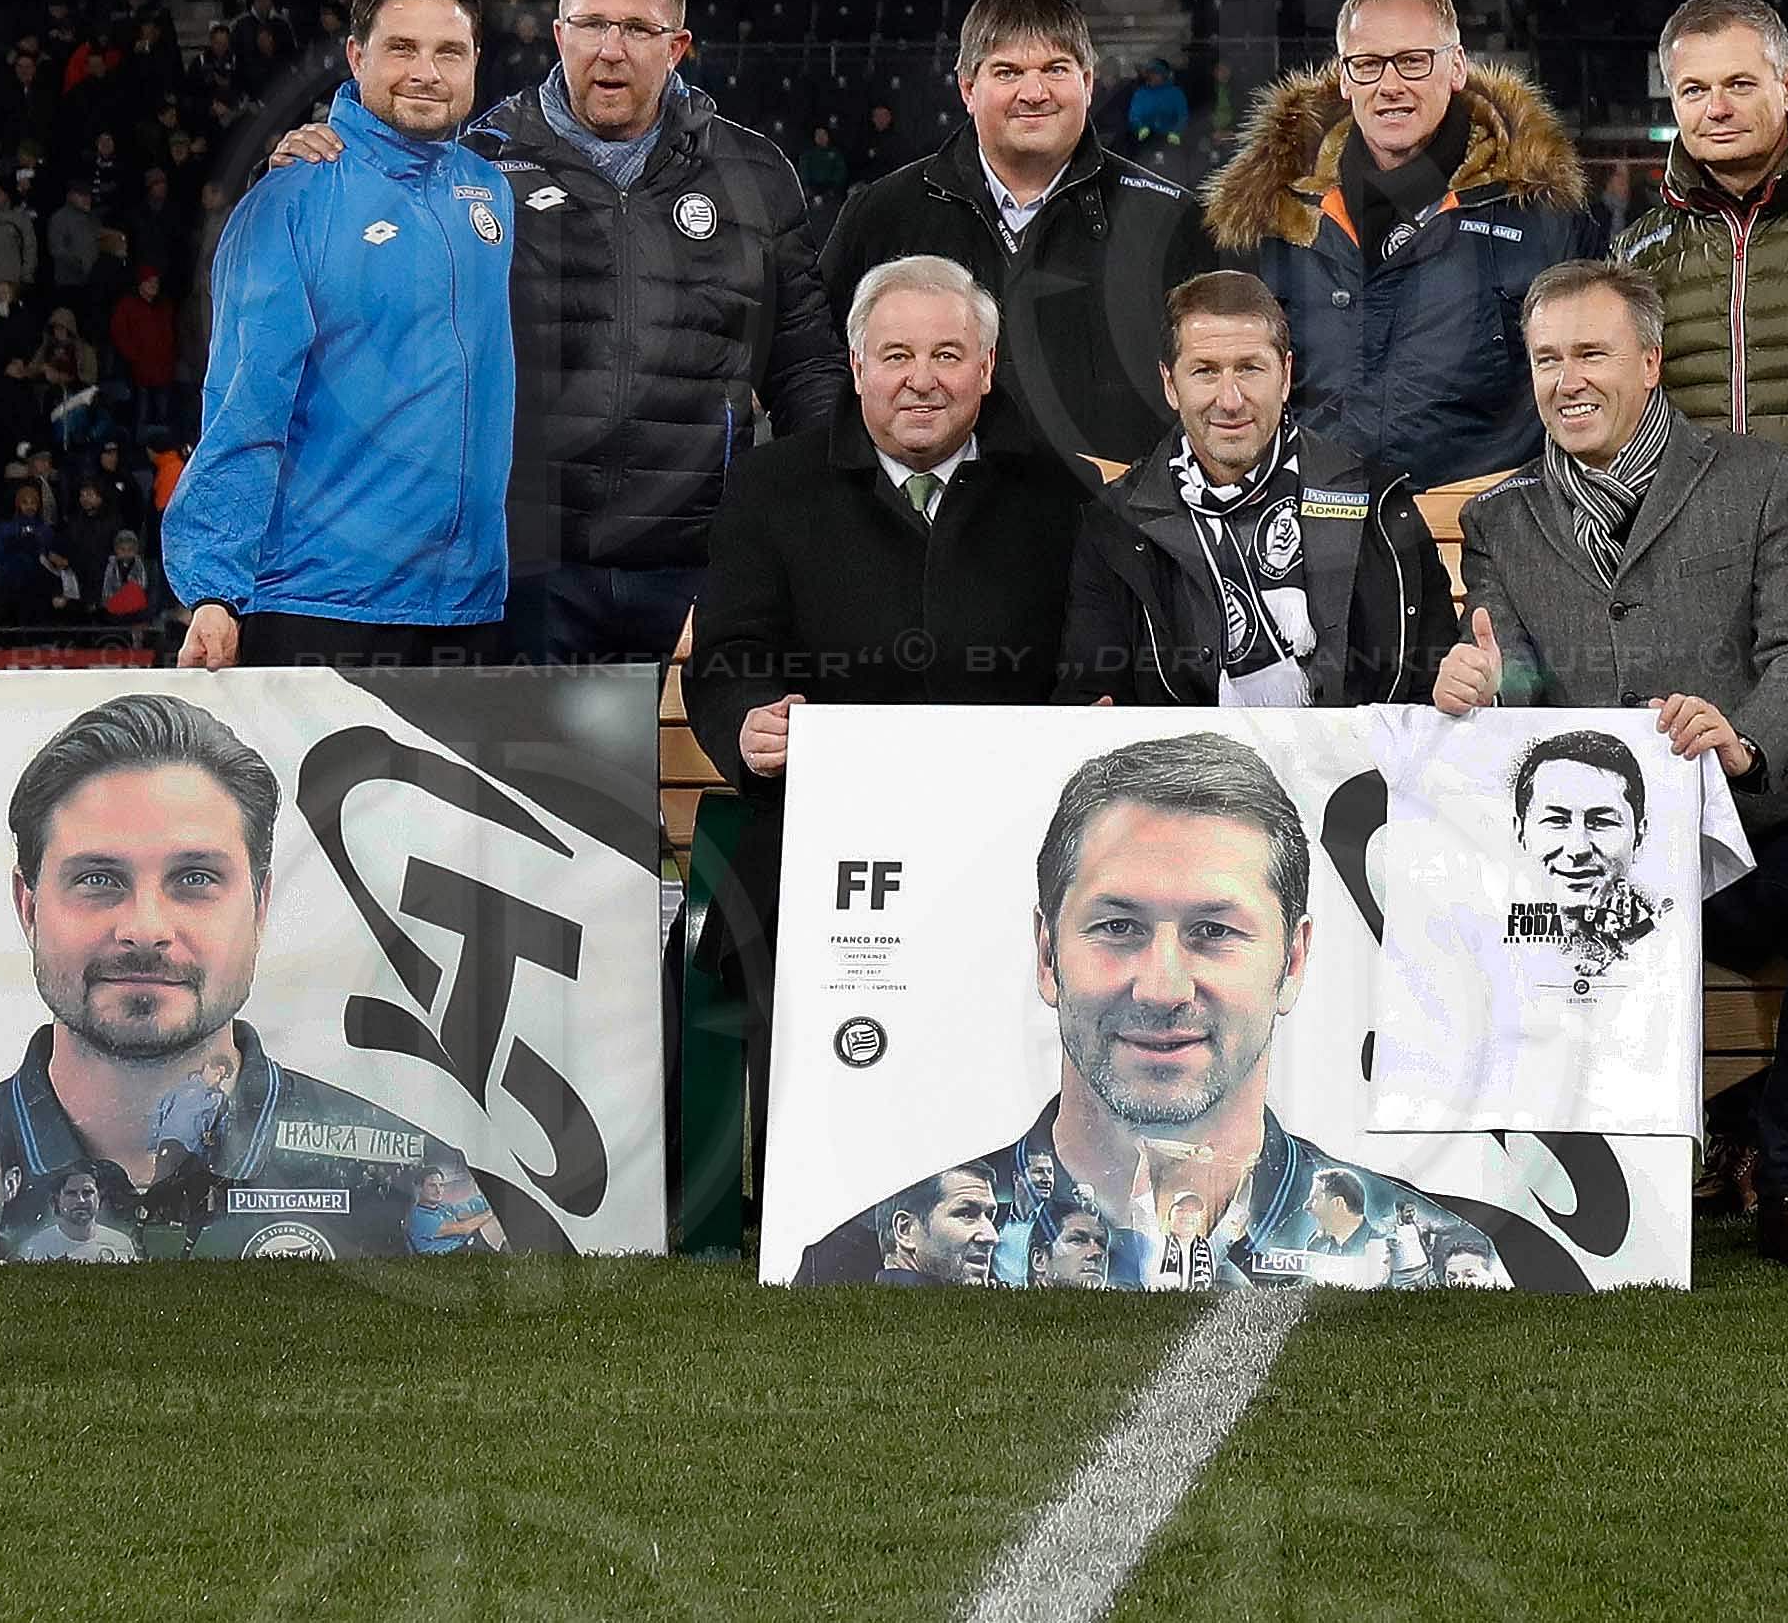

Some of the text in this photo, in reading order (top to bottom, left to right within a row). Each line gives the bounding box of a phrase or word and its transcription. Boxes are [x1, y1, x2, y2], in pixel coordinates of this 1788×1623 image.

[1304, 504, 1365, 517] ADMIRAL
[836, 861, 902, 910] FF
[1511, 903, 1557, 915] FRANCO
[1508, 915, 1564, 936] FODA
[830, 935, 901, 945] FRANCO FODA
[283, 1121, 422, 1159] HAJRA IMRE
[235, 1192, 342, 1209] PUNTIGAMER
